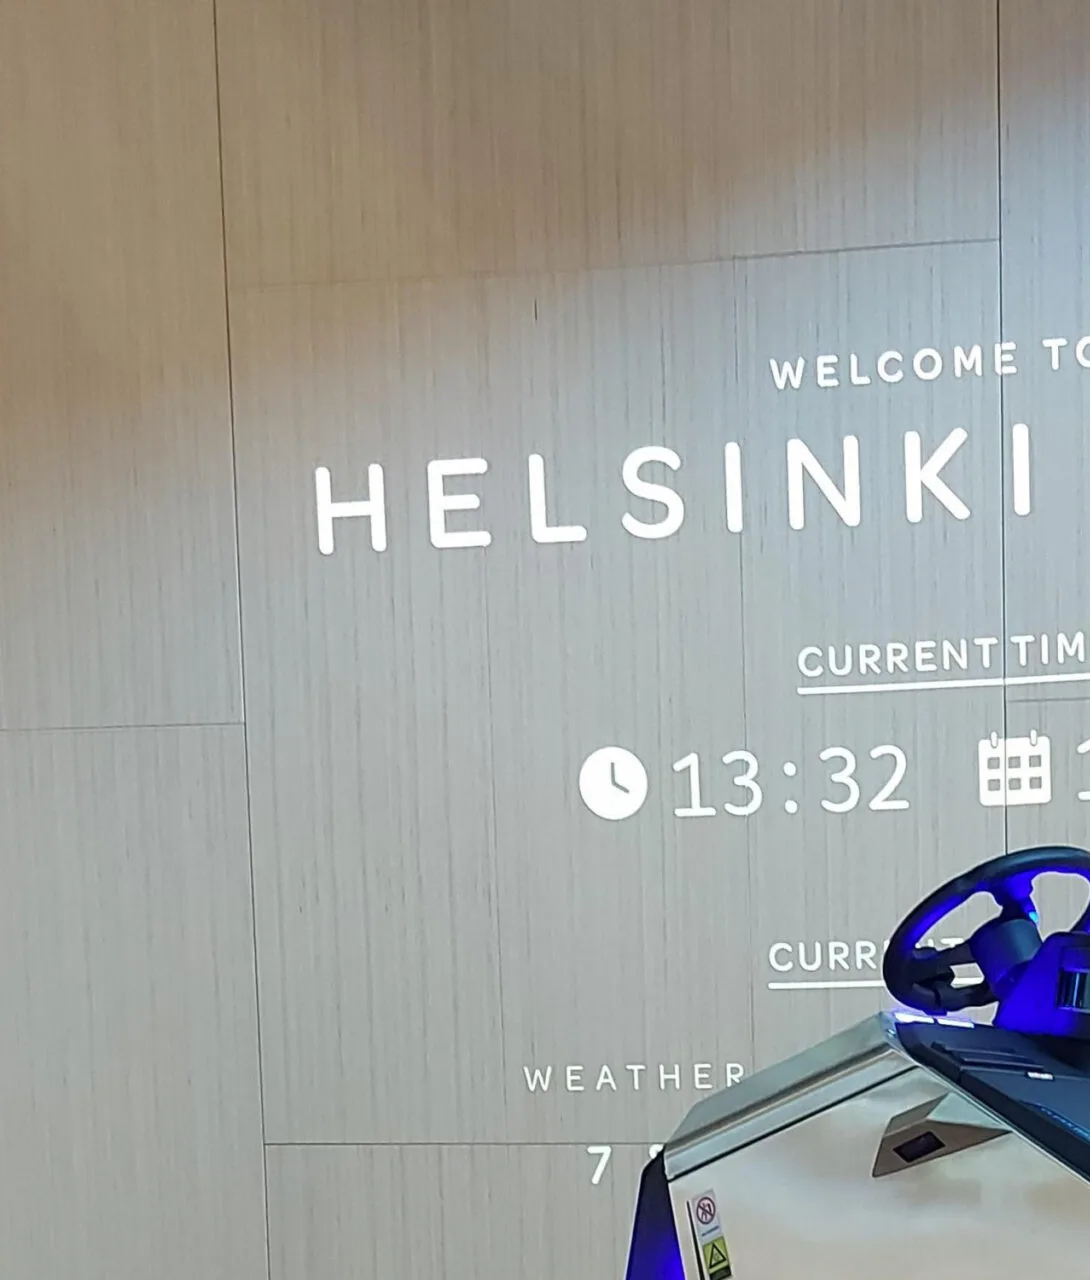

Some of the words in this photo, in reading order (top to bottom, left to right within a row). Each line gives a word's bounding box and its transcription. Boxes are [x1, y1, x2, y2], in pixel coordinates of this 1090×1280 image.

[769, 341, 1018, 390] WELCOME
[314, 422, 1032, 555] HELSINKI
[797, 636, 1000, 678] CURRENT
[671, 744, 911, 817] 13:32
[523, 1062, 745, 1092] WEATHER
[587, 1145, 612, 1185] 7
